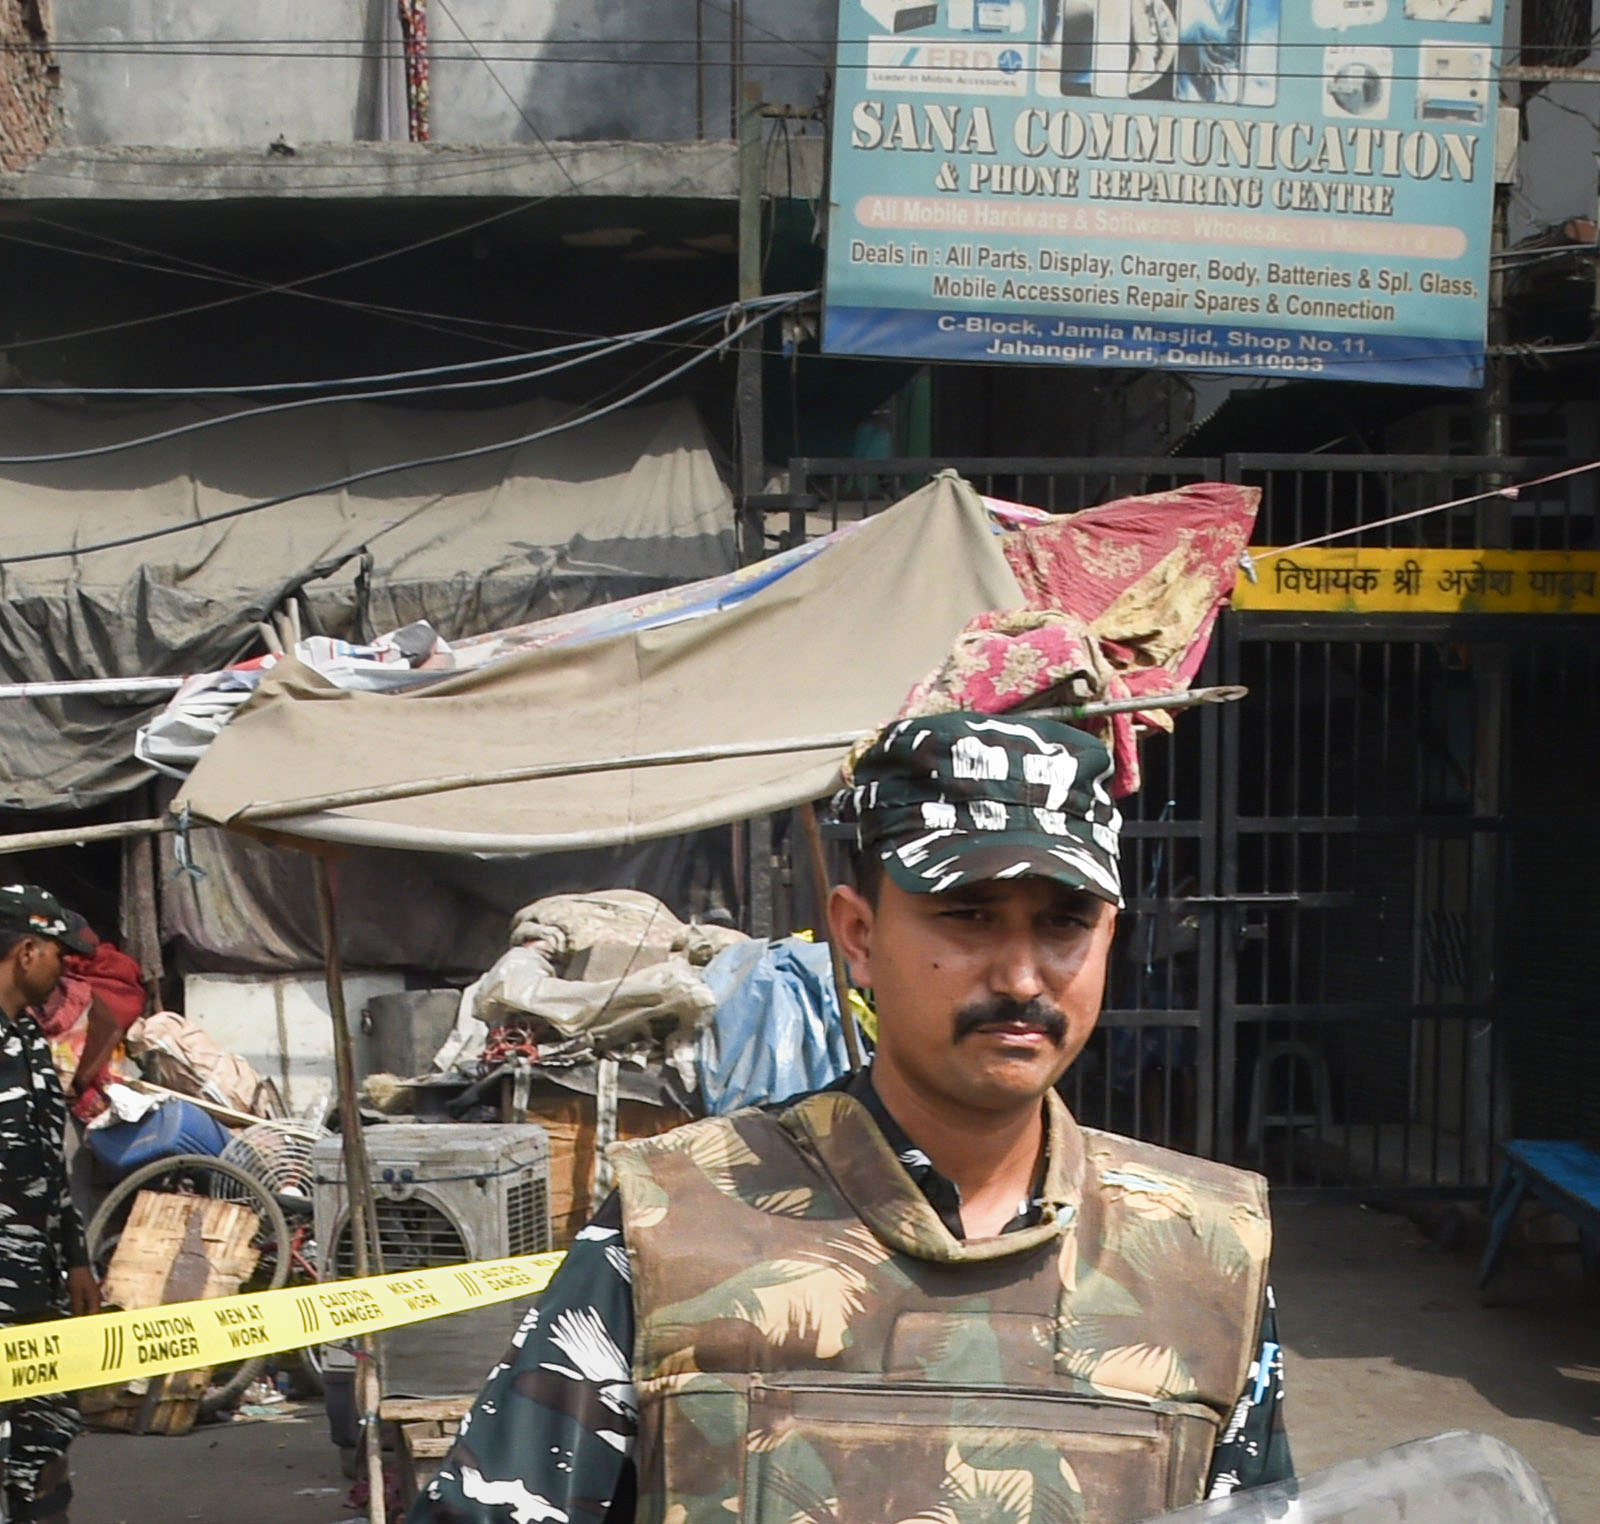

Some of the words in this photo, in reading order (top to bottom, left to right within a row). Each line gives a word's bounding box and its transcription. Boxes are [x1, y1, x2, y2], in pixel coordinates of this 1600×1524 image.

[851, 100, 997, 155] SANA
[1013, 108, 1479, 183] COMMUNICATION
[935, 161, 959, 194] &
[968, 162, 1079, 198] PHONE
[1088, 167, 1263, 208] REPAIRING
[1271, 177, 1394, 215] CENTRE
[903, 201, 969, 226] Mobile
[975, 204, 1068, 231] Hardware
[1073, 208, 1088, 231] &
[851, 241, 904, 264] Deals
[911, 244, 928, 266] in
[945, 246, 971, 267] All
[978, 247, 1032, 272] Parts,
[1039, 250, 1113, 277] Display,
[1120, 254, 1201, 283] Charger,
[1207, 259, 1260, 286] Body,
[1267, 263, 1351, 288] Batteries
[1358, 268, 1371, 289] &
[1377, 270, 1413, 295] Spl.
[1420, 272, 1478, 298] Glass,
[933, 275, 997, 298] Mobile
[1001, 279, 1119, 304] Accessories
[1126, 285, 1188, 311] Repair
[1194, 290, 1260, 314] Spares
[1266, 293, 1280, 314] &
[1286, 295, 1395, 321] Connection
[937, 316, 1043, 338] C-Block,
[1050, 320, 1124, 341] Jamia
[1132, 325, 1219, 347] Masjid,
[1227, 330, 1291, 352] Shop
[986, 338, 1095, 361] Jahangir
[1103, 345, 1159, 365] Puri,
[1275, 557, 1380, 595] विधायक
[1392, 558, 1423, 597] श्री
[1437, 561, 1513, 598] अजेश
[386, 1281, 415, 1296] MEN
[487, 1274, 536, 1292] DANGER
[319, 1289, 374, 1309] CAUTION
[404, 1293, 441, 1312] WORK
[213, 1308, 246, 1327] MEN
[249, 1304, 264, 1319] AT
[329, 1303, 385, 1327] DANGER
[131, 1316, 196, 1342] CAUTION
[228, 1325, 270, 1348] WORK
[4, 1338, 40, 1363] MEN
[43, 1335, 61, 1356] AT
[138, 1338, 200, 1364] DANGER
[11, 1361, 59, 1387] WORK
